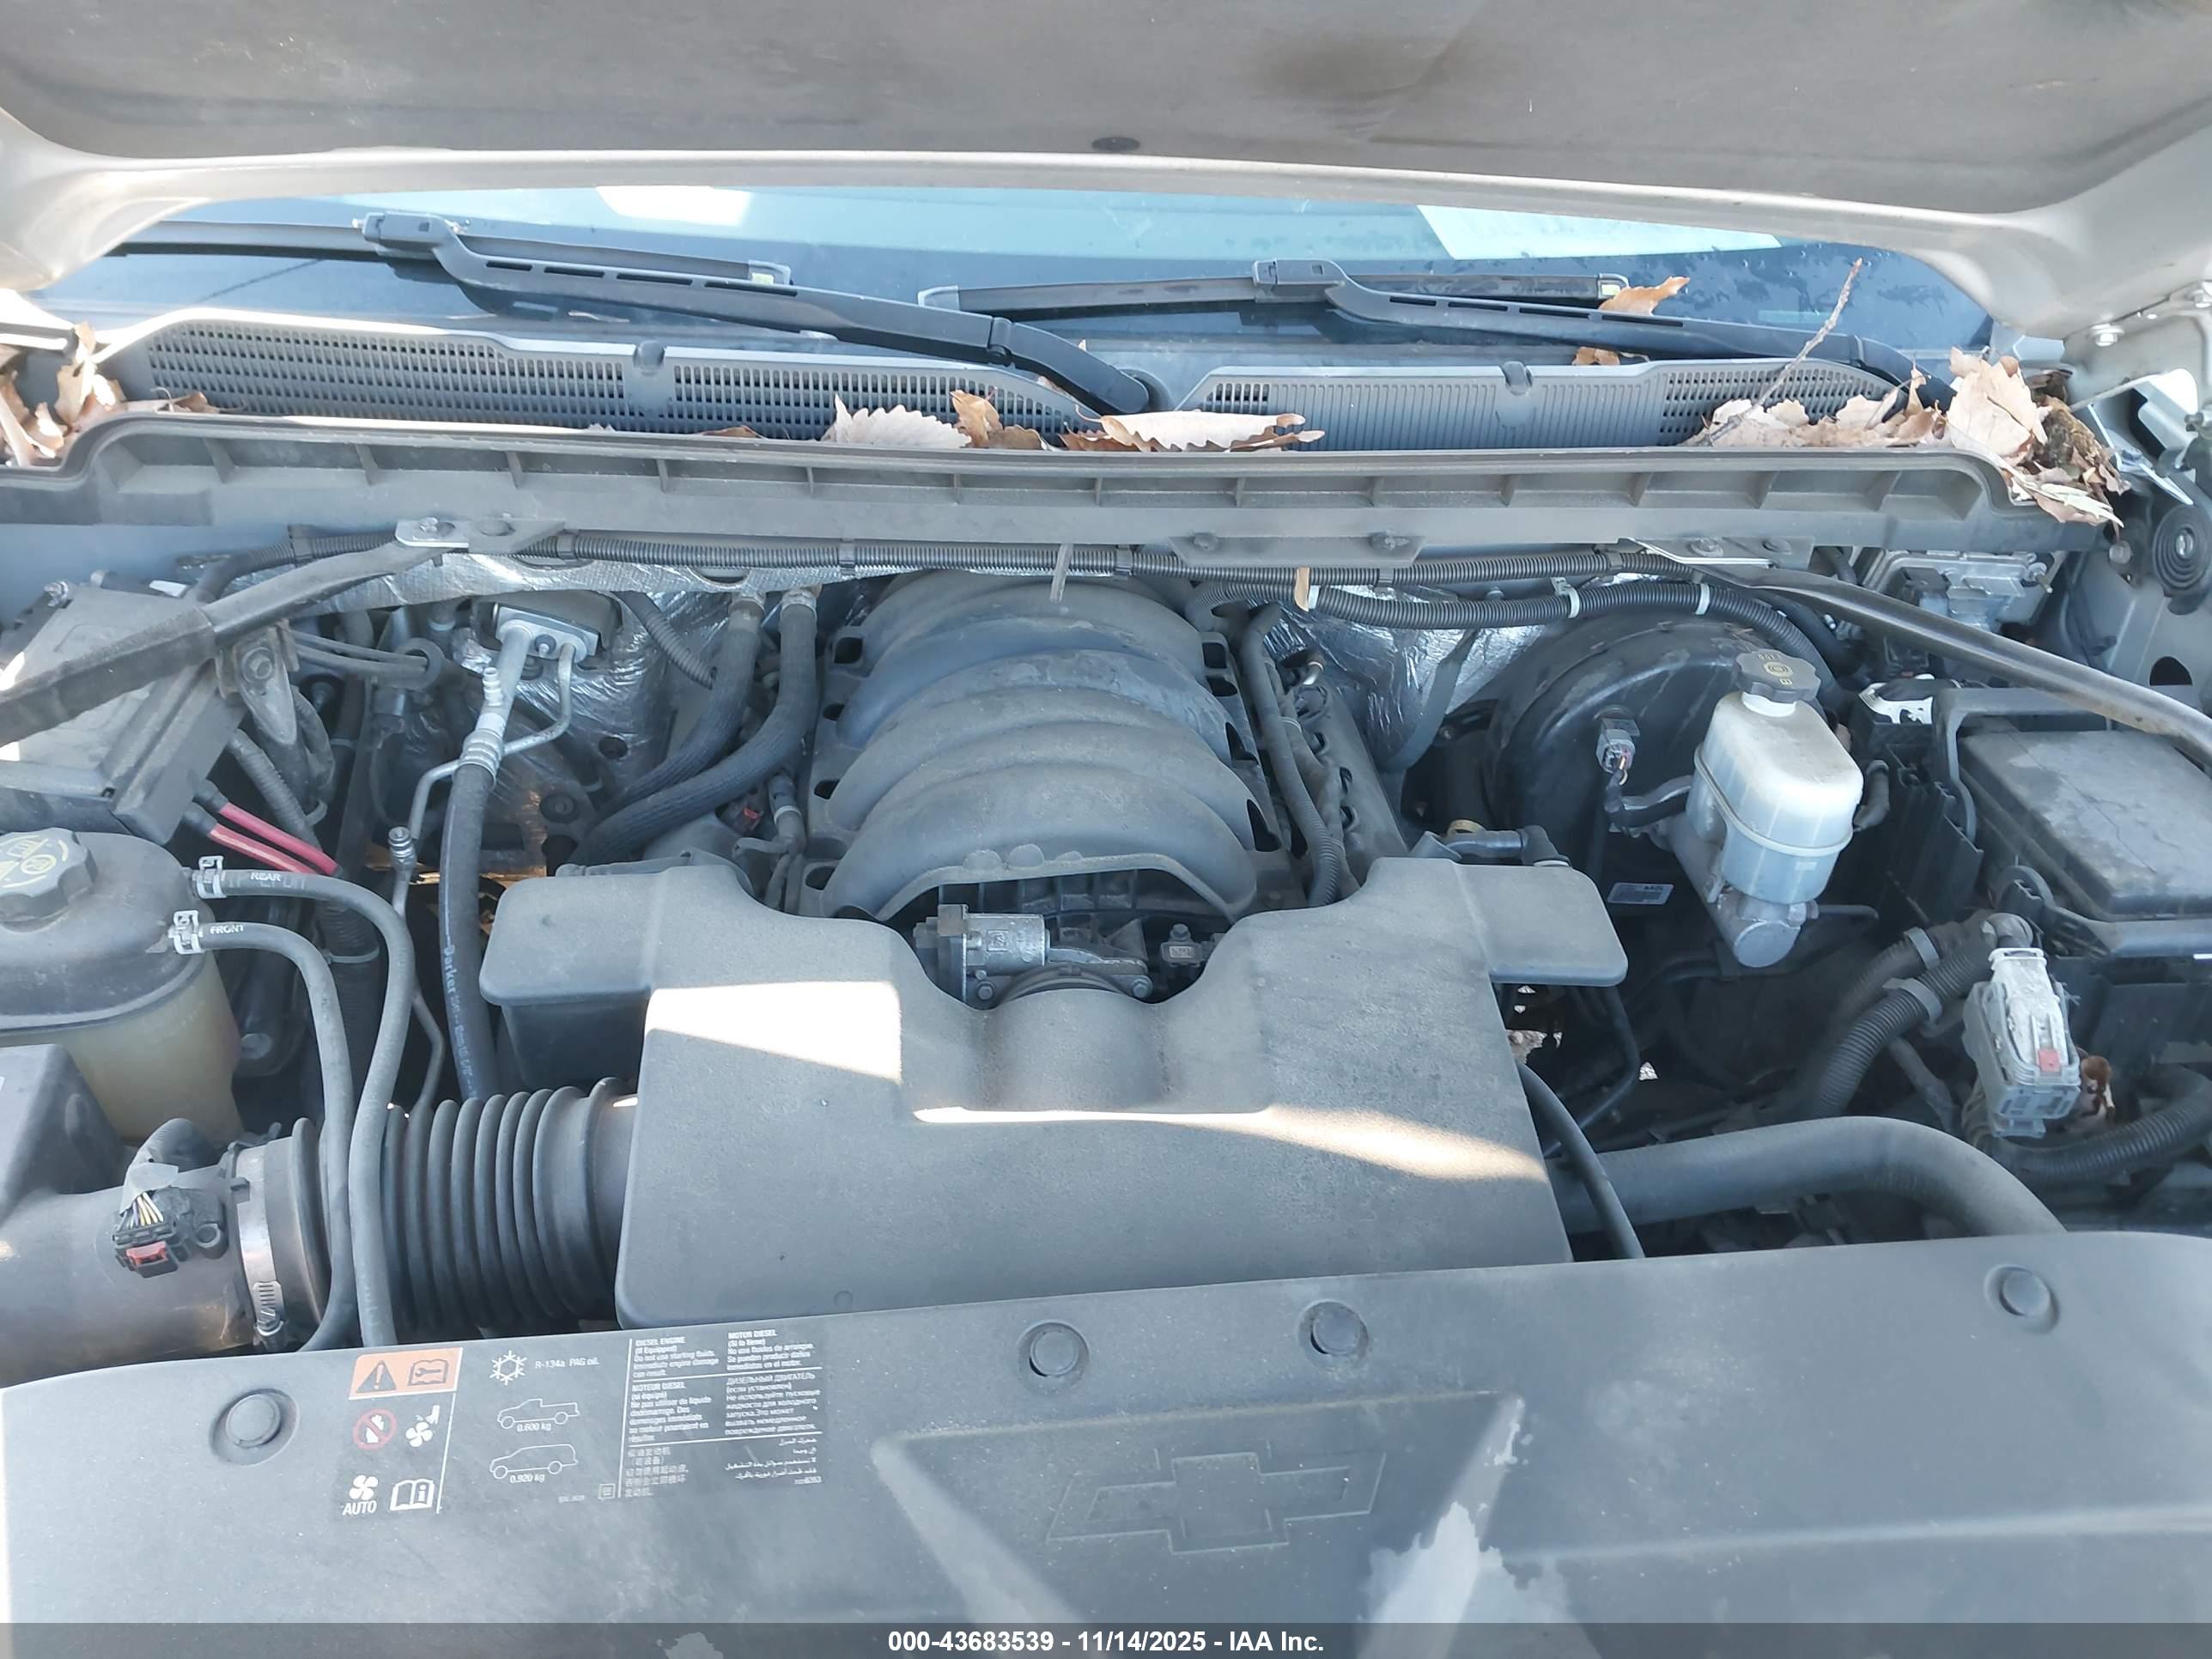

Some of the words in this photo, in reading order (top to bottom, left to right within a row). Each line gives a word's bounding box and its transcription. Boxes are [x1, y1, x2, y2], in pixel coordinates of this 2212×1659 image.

[250, 872, 282, 882] REAR
[210, 924, 245, 935] FRONT
[343, 1500, 378, 1516] AUTO
